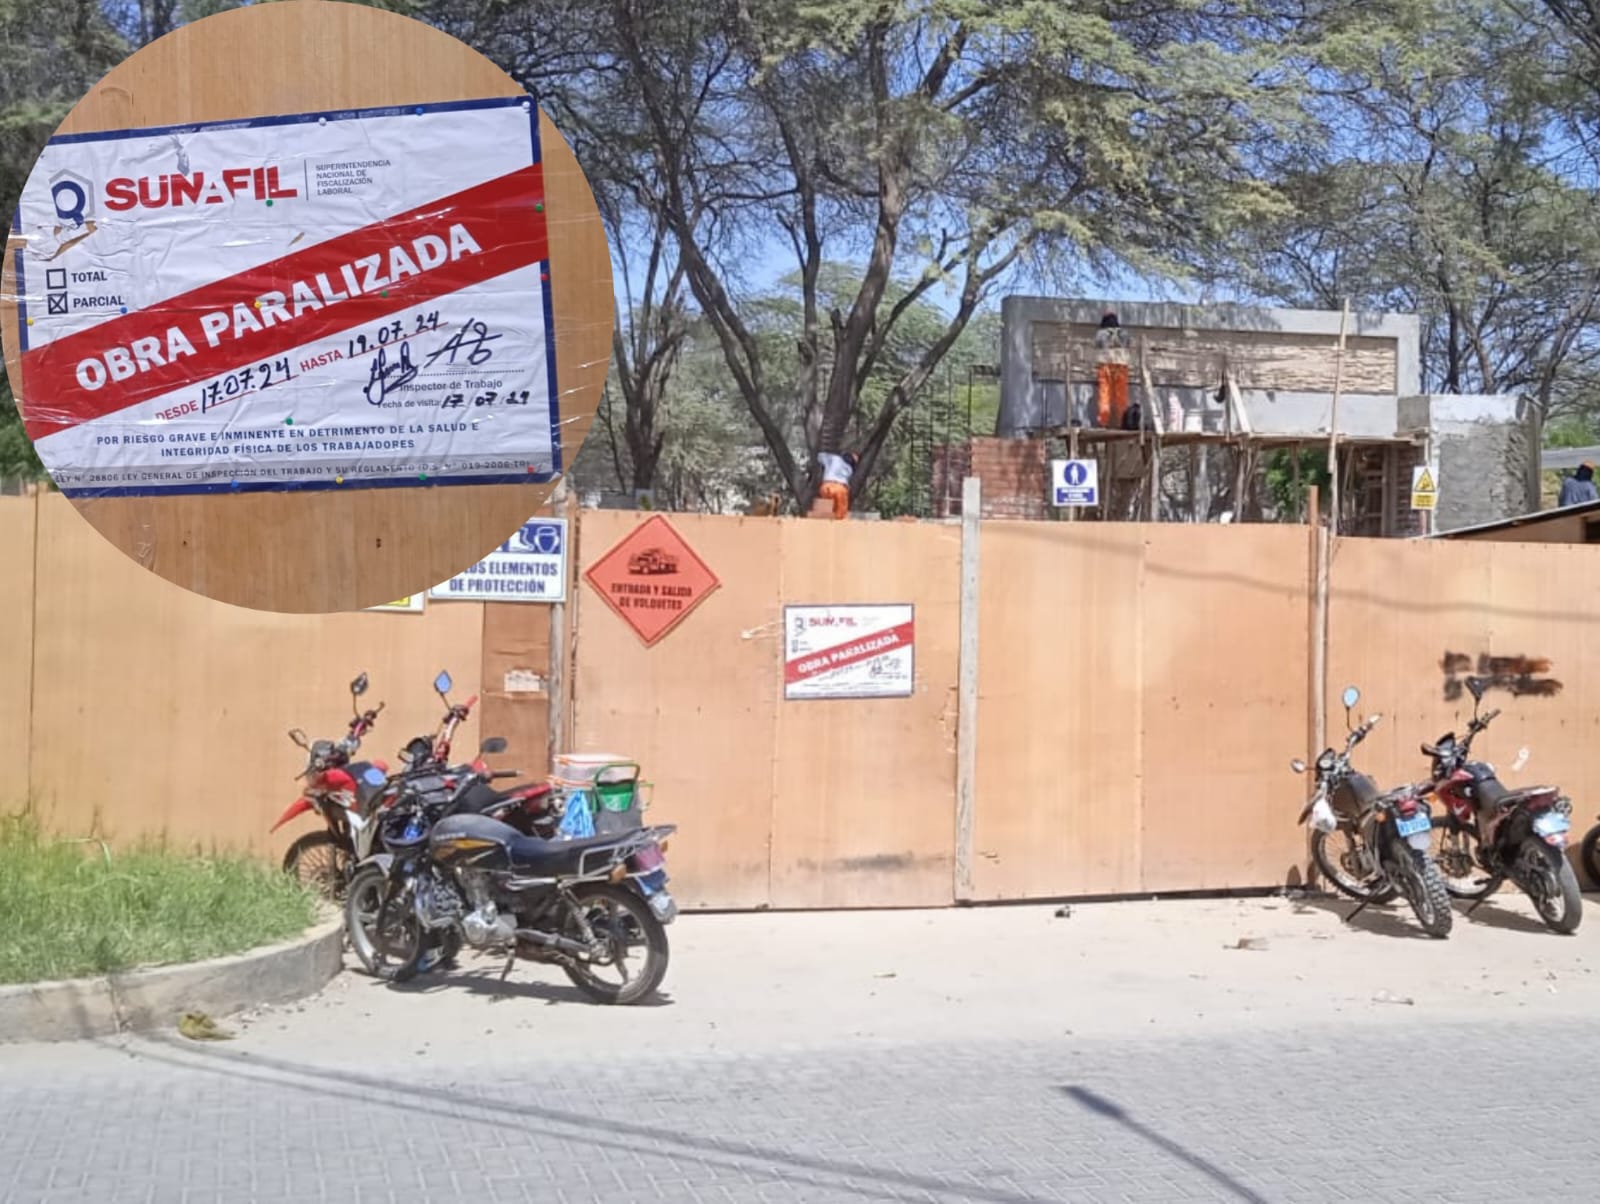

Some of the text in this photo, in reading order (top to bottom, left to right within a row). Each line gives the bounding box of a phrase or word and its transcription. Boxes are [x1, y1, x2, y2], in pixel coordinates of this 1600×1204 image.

[316, 160, 391, 171] SUPERINTENDENCIA
[316, 169, 367, 179] NACIONAL DE
[104, 165, 298, 211] SUNAFIL
[317, 177, 373, 187] FISCALIZACIÓN
[317, 187, 353, 196] LABORAL
[71, 271, 107, 282] TOTAL
[73, 296, 125, 308] PARCIAL
[75, 326, 197, 391] OBRA
[199, 223, 482, 348] PARALIZADA
[155, 400, 199, 421] DESDE
[300, 349, 343, 372] HASTA
[399, 379, 503, 392] Inspector de Trabajo
[404, 400, 415, 408] de
[97, 422, 480, 445] POR RIESGO GRAVE E INMINENTE EN DETRIMENTO DE LA SALUD E
[161, 439, 415, 457] INTEGRIDAD FÍSICA DE LOS TRABAJADORES
[122, 473, 138, 481] LEY
[142, 471, 182, 481] GENERAL
[186, 471, 198, 479] DE
[260, 469, 277, 477] DEL
[282, 466, 322, 475] TRABAJO
[489, 561, 558, 576] ELEMENTOS
[450, 578, 545, 592] DE PROTECCIÓN
